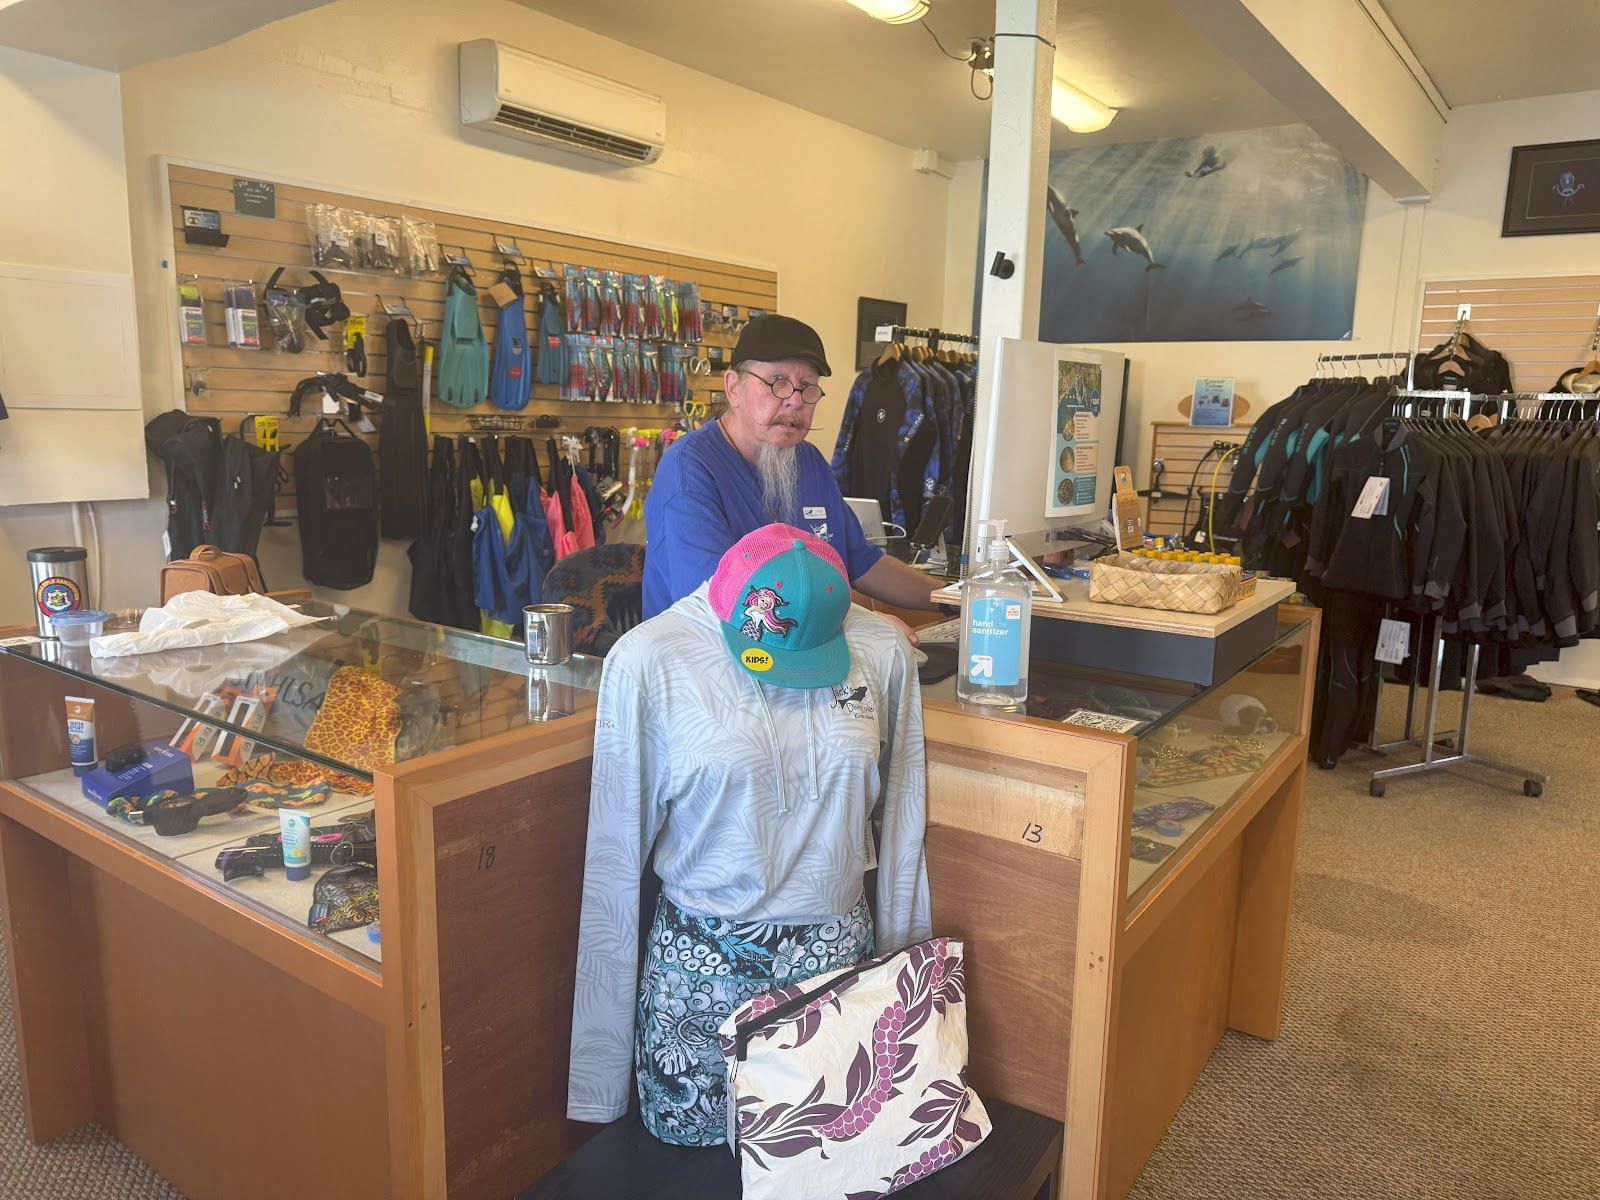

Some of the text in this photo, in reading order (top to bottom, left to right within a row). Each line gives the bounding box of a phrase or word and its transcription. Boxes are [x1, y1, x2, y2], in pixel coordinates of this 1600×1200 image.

[972, 619, 994, 628] hand
[971, 627, 1009, 636] sanitizer
[745, 655, 769, 665] KIDS!
[1021, 822, 1043, 844] 13
[478, 845, 497, 871] 18
